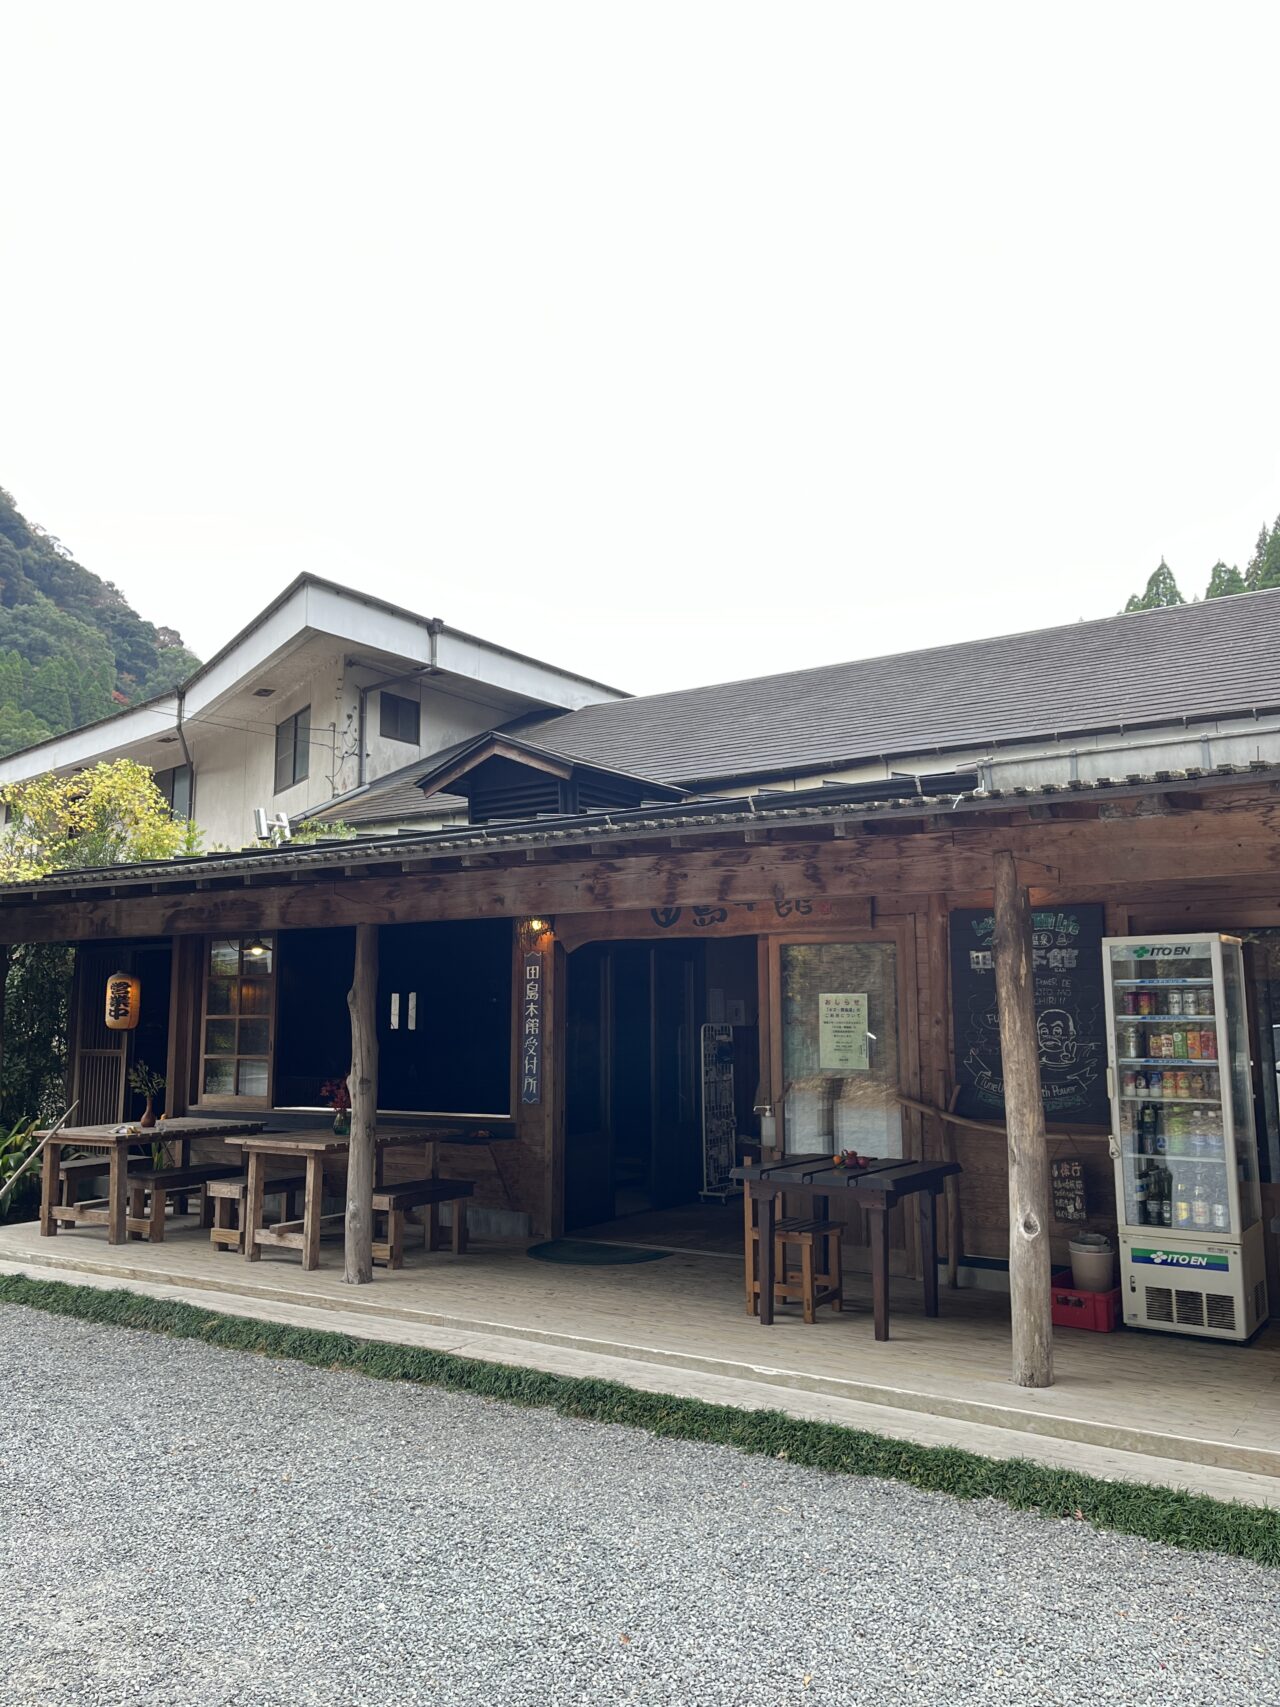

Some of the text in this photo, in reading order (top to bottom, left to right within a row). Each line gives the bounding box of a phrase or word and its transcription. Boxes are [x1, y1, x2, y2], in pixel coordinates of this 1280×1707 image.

[1150, 946, 1190, 956] ITO EN
[109, 982, 131, 1020] 営業中
[825, 998, 860, 1006] おしらせ
[1053, 1084, 1077, 1097] Power
[1167, 1254, 1207, 1266] ITO EN
